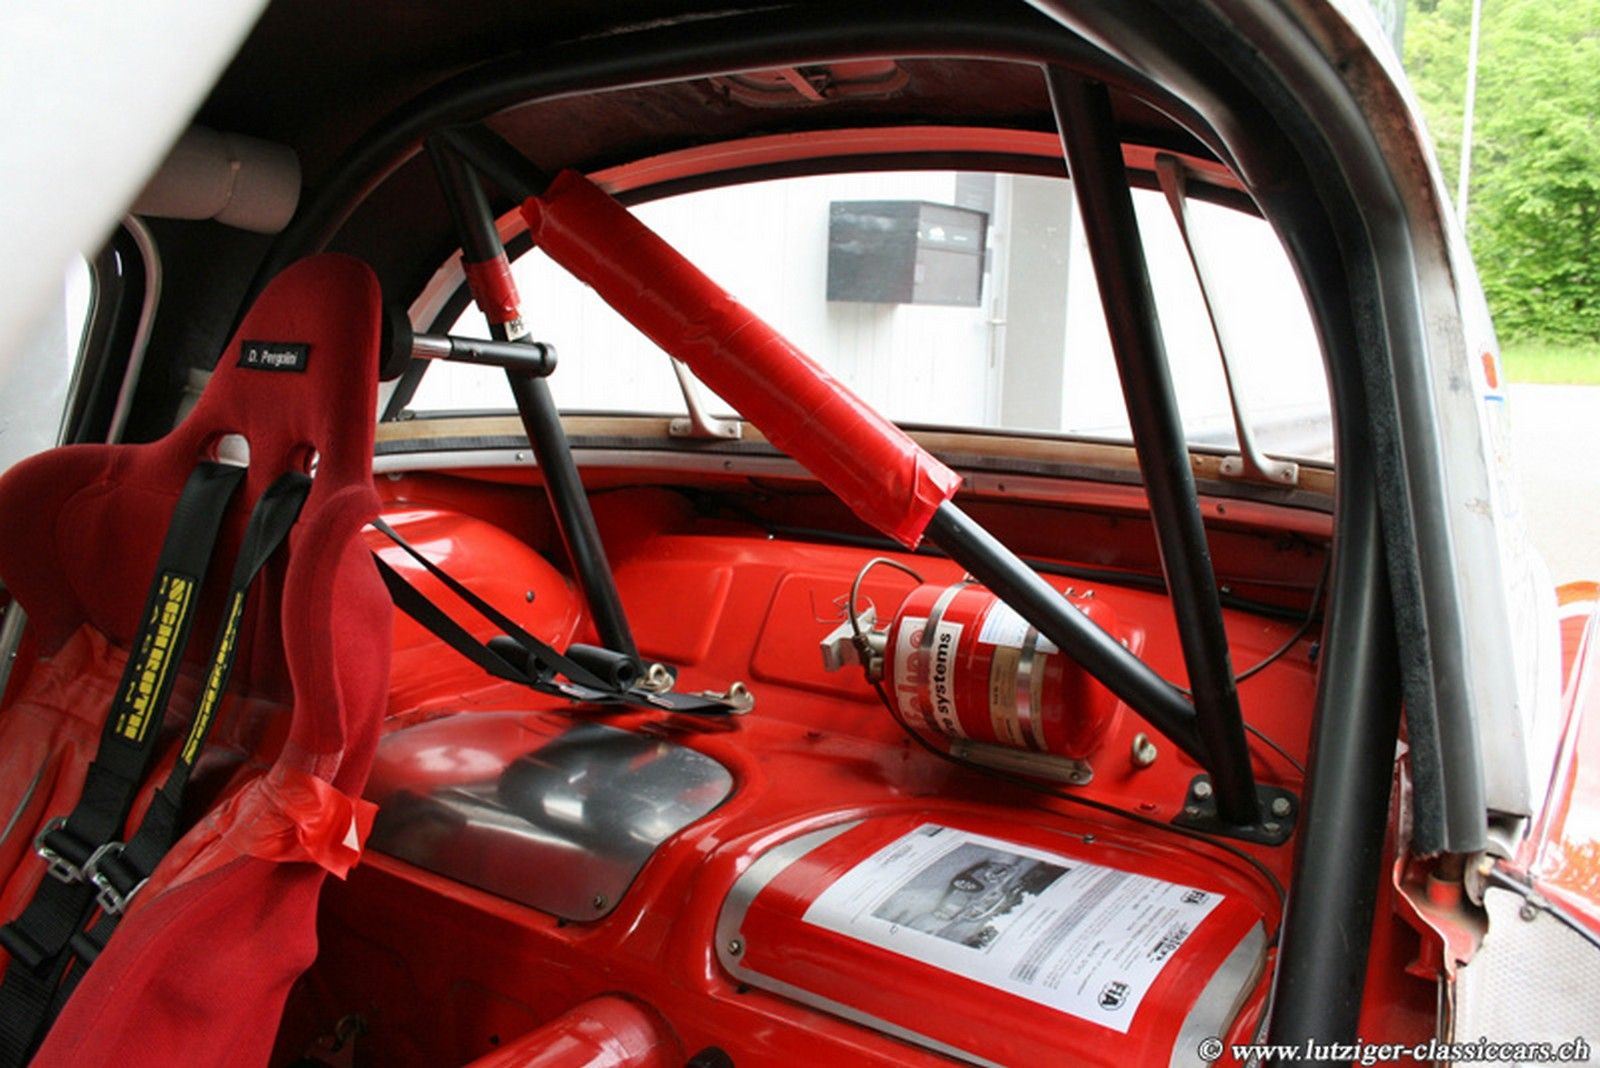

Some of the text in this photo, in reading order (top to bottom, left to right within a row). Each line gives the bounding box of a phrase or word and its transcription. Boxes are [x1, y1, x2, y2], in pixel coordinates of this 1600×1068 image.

[123, 577, 187, 741] SCHROTH
[933, 632, 952, 715] systems
[1101, 981, 1129, 1006] FIA
